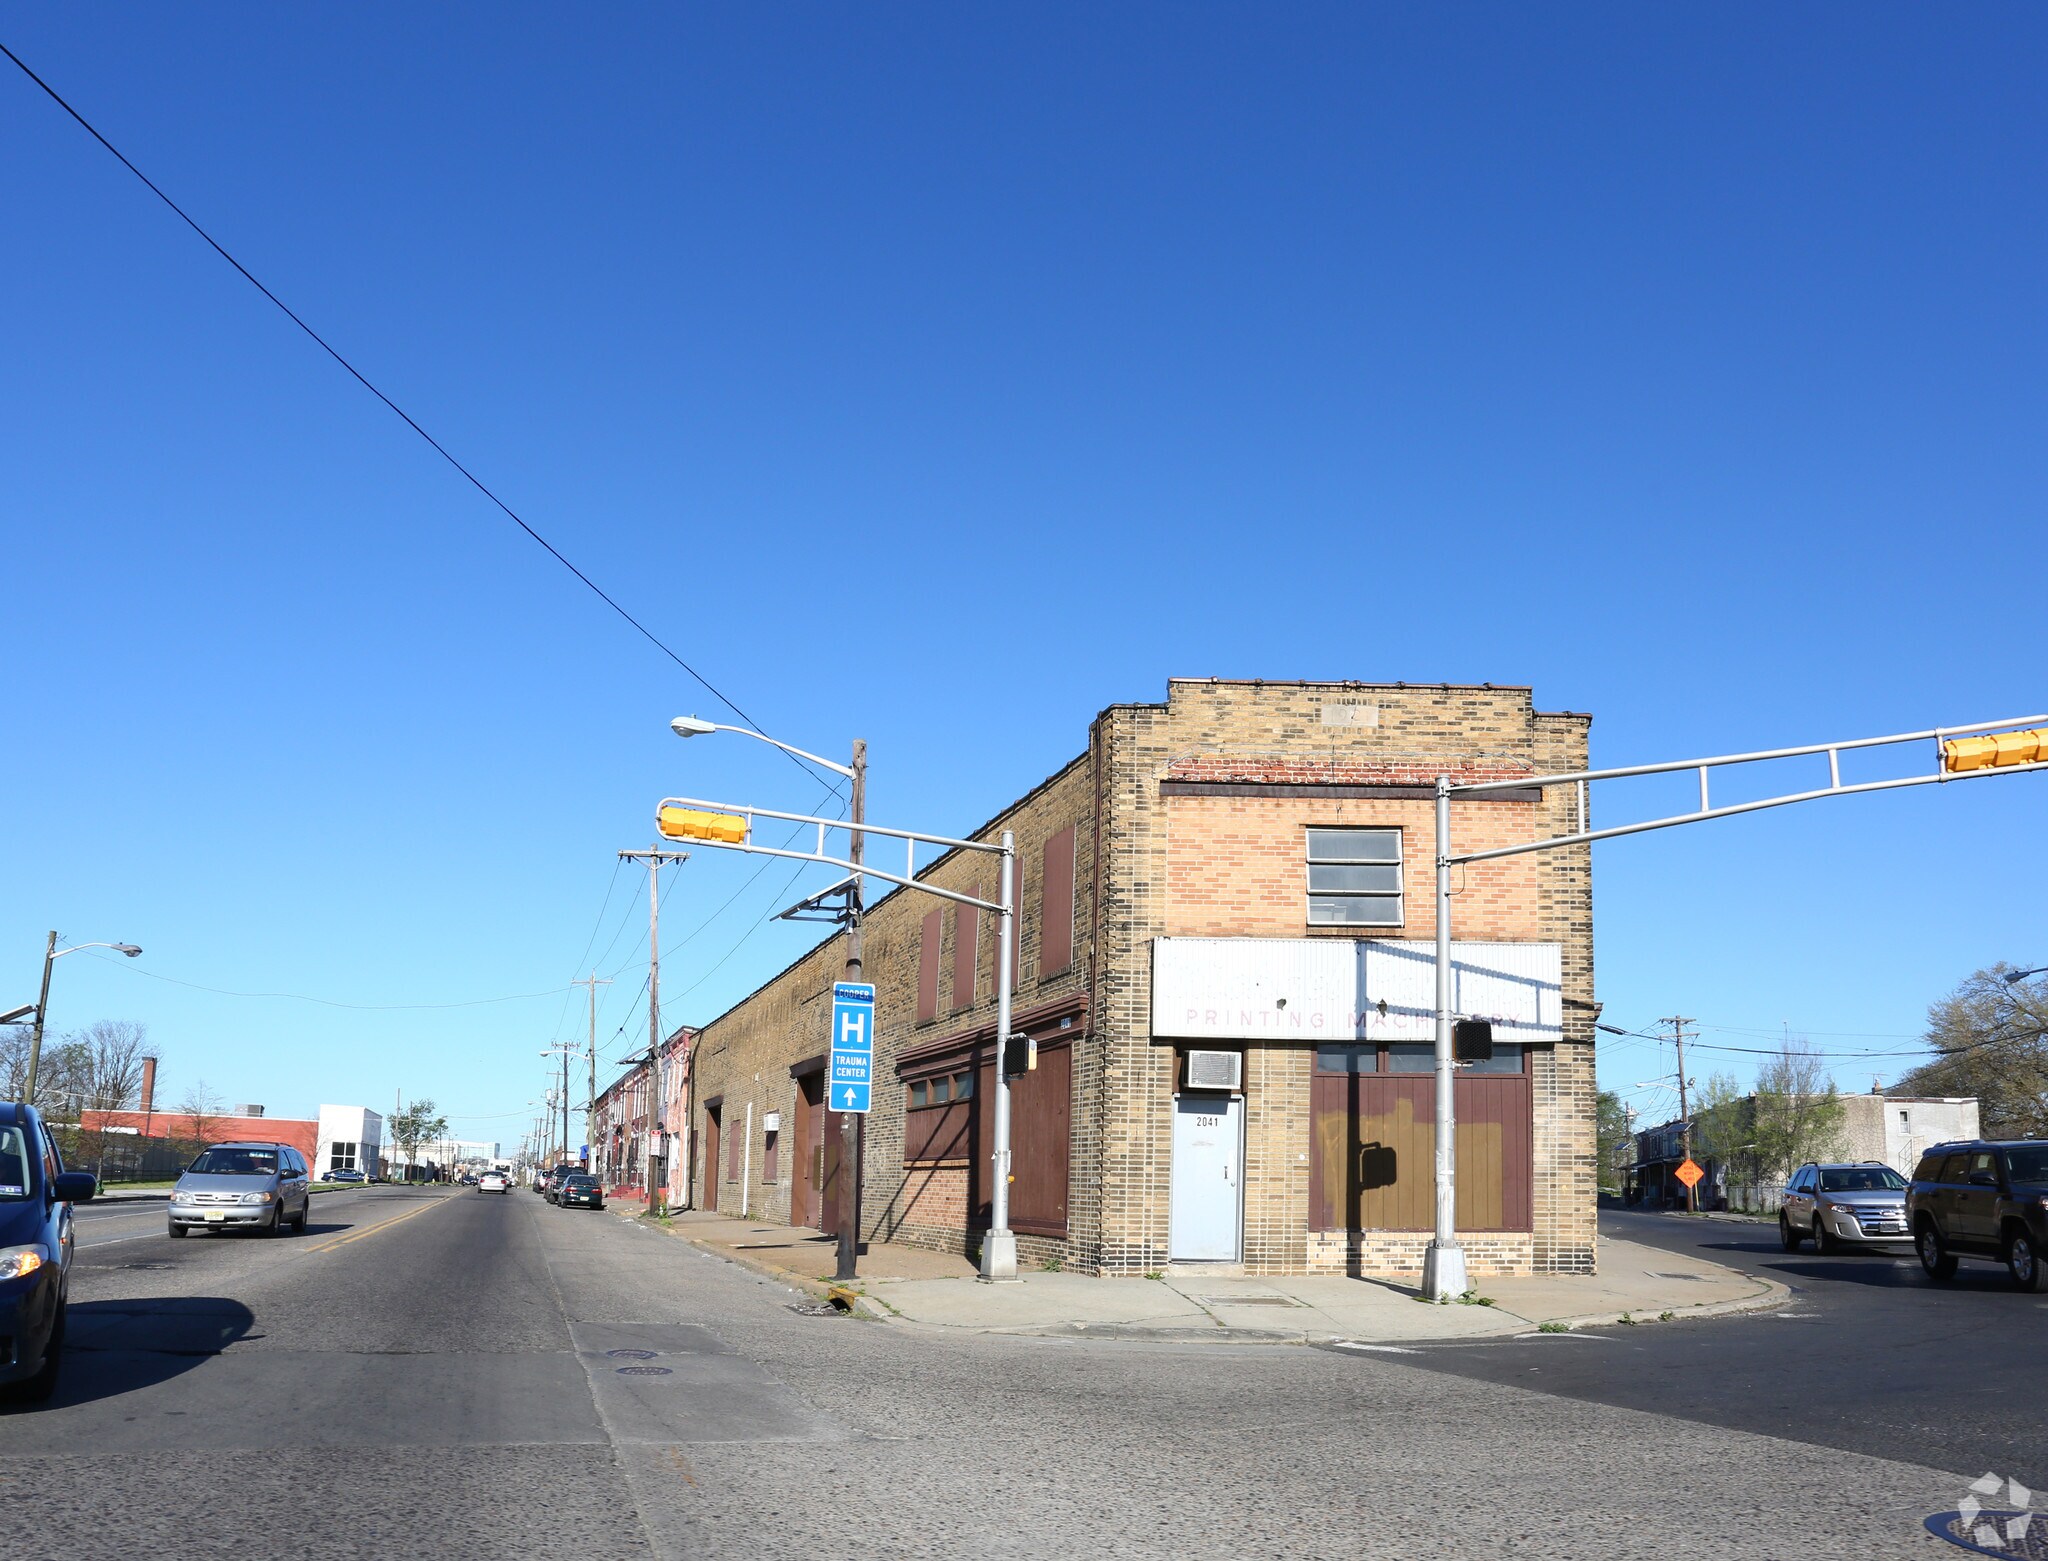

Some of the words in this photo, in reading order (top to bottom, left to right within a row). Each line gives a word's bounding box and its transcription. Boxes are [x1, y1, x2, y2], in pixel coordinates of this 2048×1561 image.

[839, 988, 870, 999] COOPER
[1186, 1008, 1324, 1029] PRINTING
[1347, 1010, 1521, 1030] MACHERY
[841, 1012, 865, 1043] H
[836, 1055, 867, 1067] TRAUMA
[836, 1067, 866, 1078] CENTER
[1196, 1116, 1219, 1127] 2041
